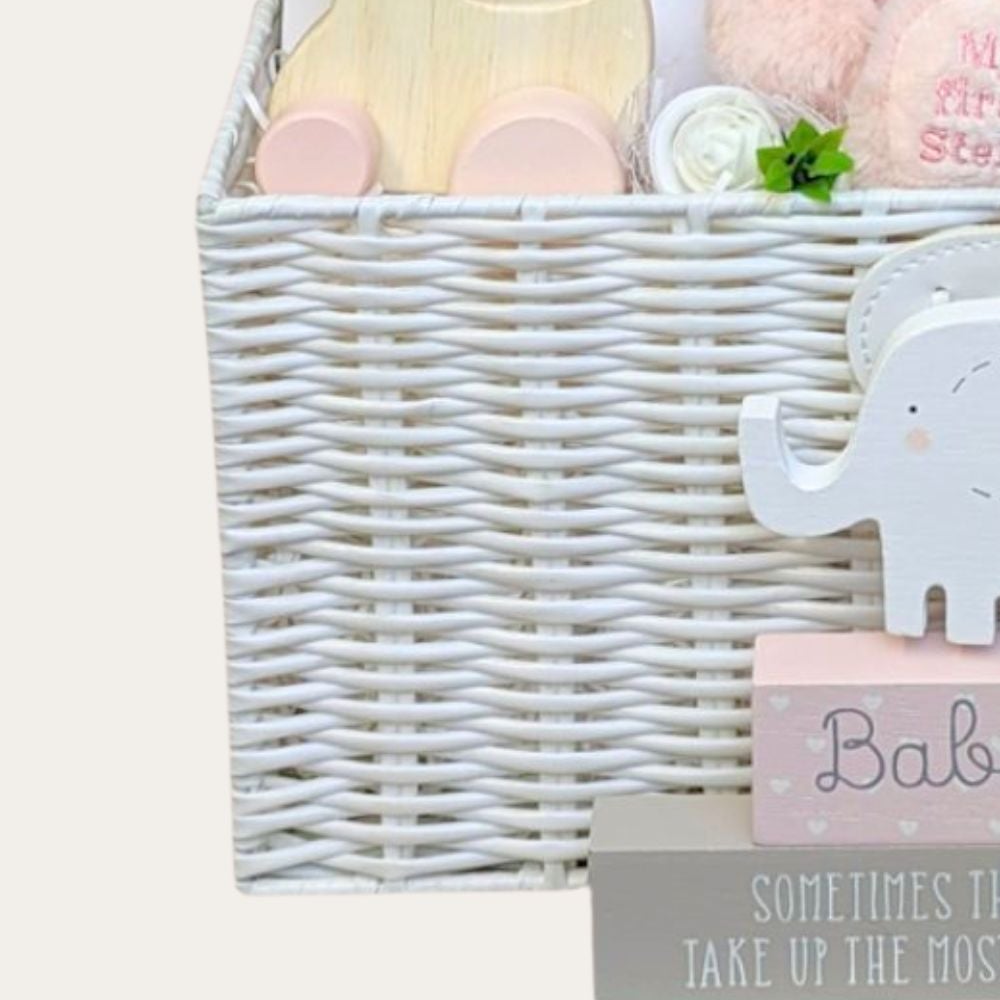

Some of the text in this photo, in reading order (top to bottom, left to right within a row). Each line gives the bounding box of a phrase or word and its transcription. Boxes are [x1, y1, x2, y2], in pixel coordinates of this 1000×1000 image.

[751, 870, 952, 923] SOMETIMES
[684, 937, 773, 989] TAKE
[790, 936, 828, 987] UP
[845, 935, 910, 986] THE
